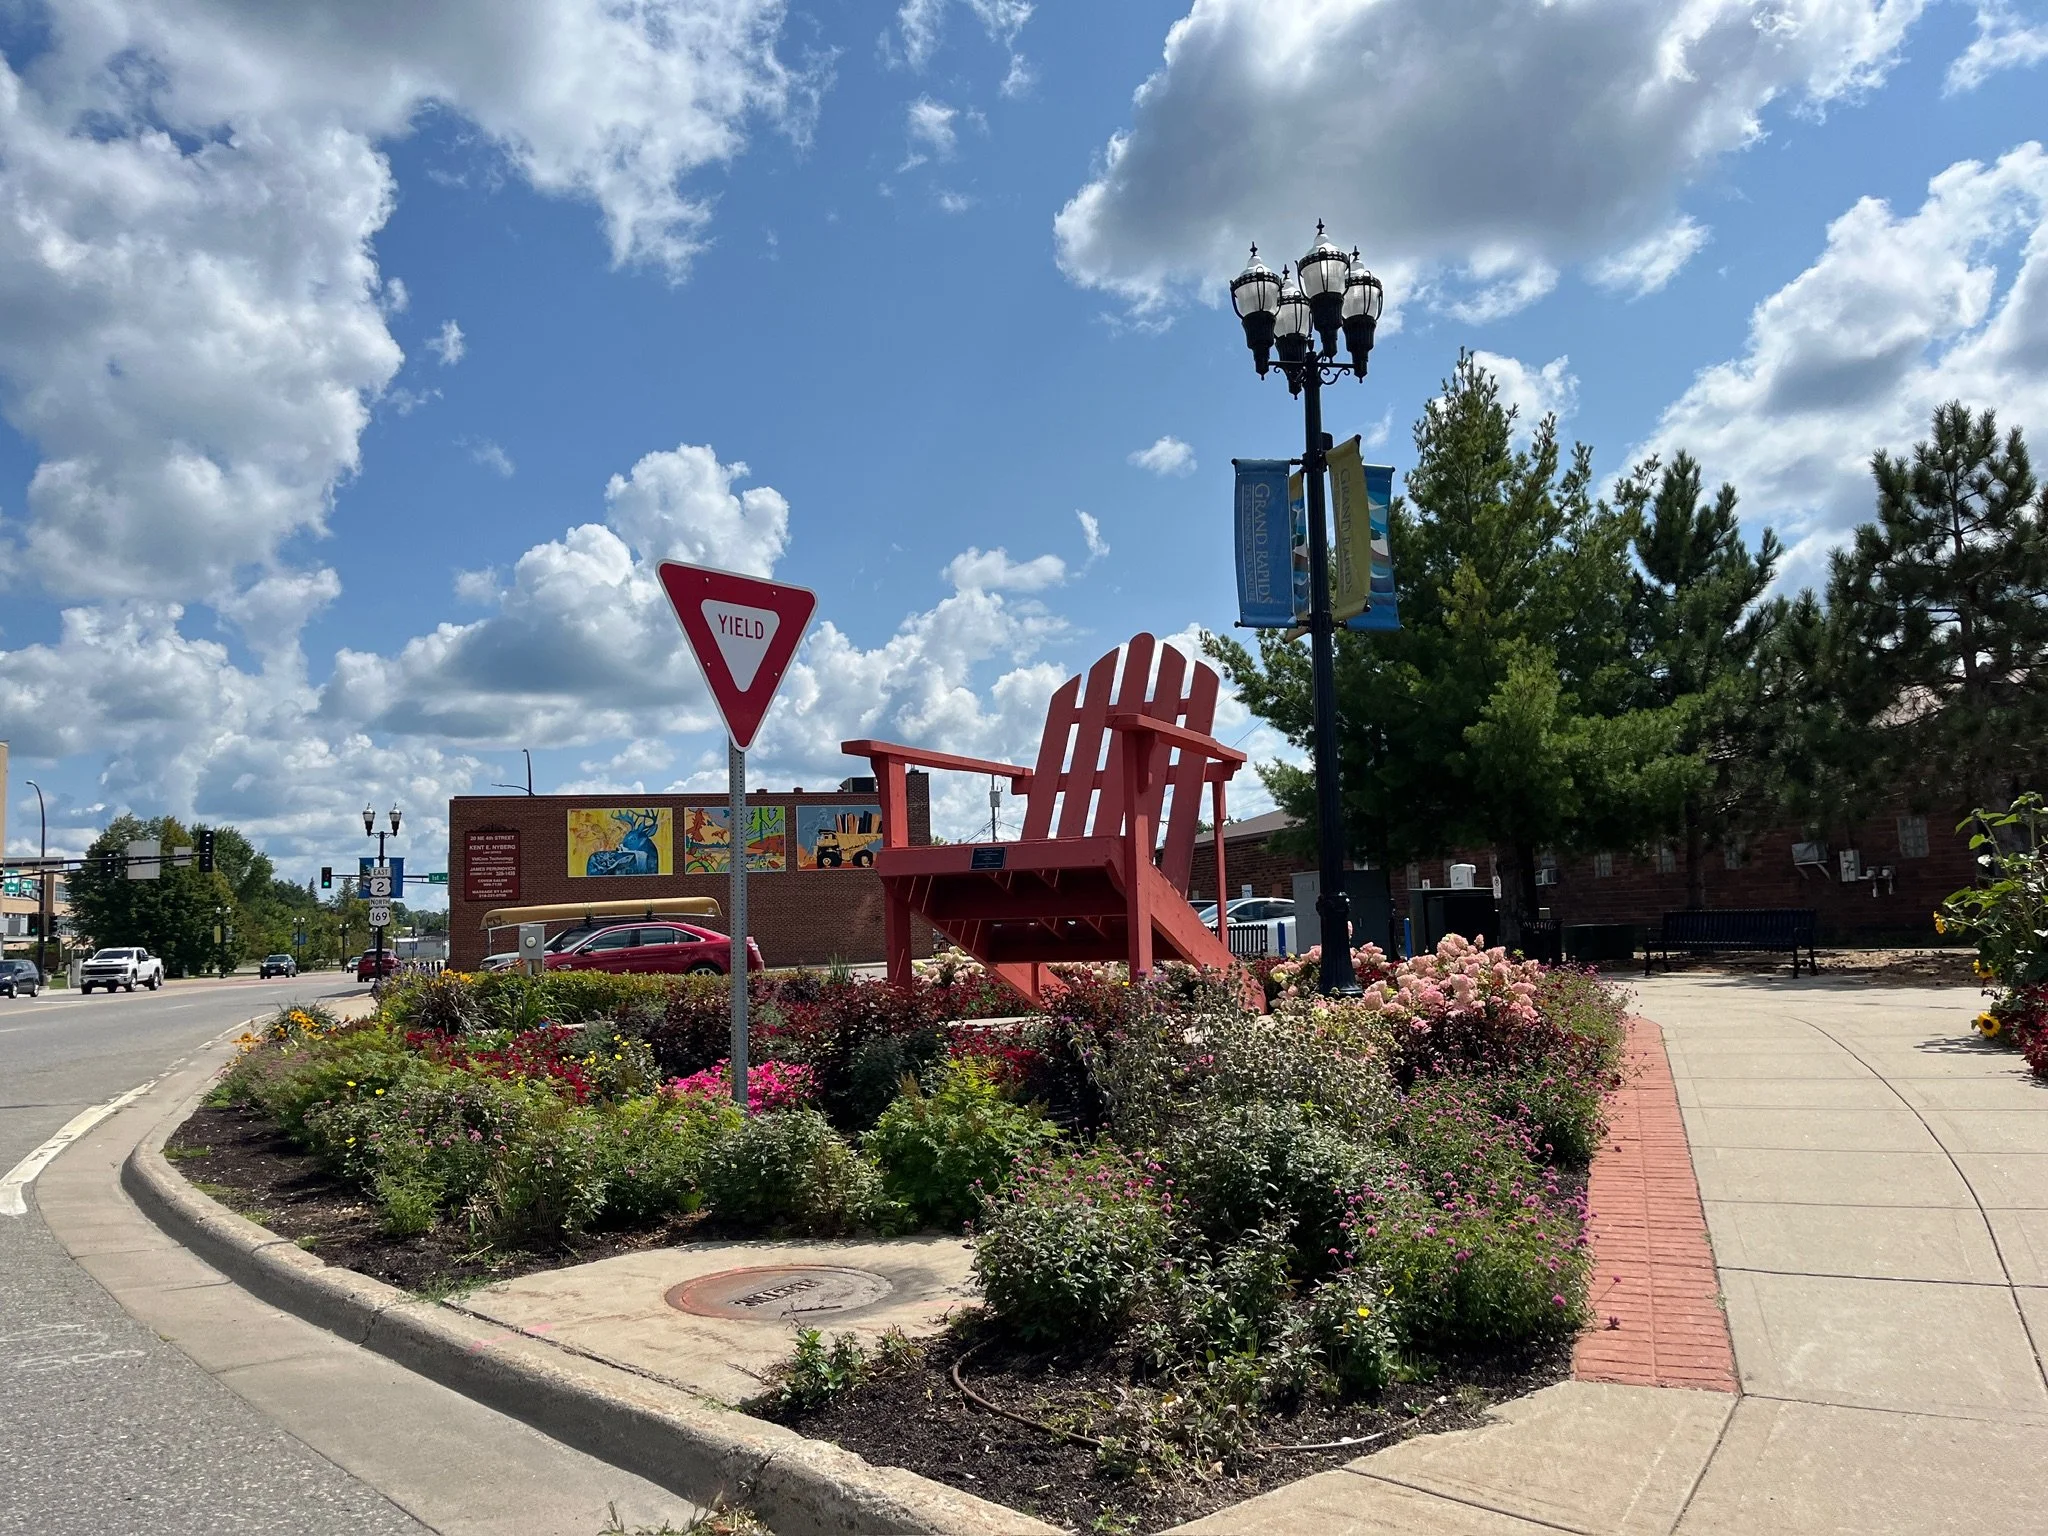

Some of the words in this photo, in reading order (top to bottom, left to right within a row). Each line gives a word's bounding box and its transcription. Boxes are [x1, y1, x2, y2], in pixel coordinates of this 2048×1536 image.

[1254, 483, 1270, 545] GRAND
[1256, 551, 1273, 604] RAPIDS
[718, 614, 764, 640] YIELD
[376, 881, 385, 892] 2
[372, 912, 388, 921] 169
